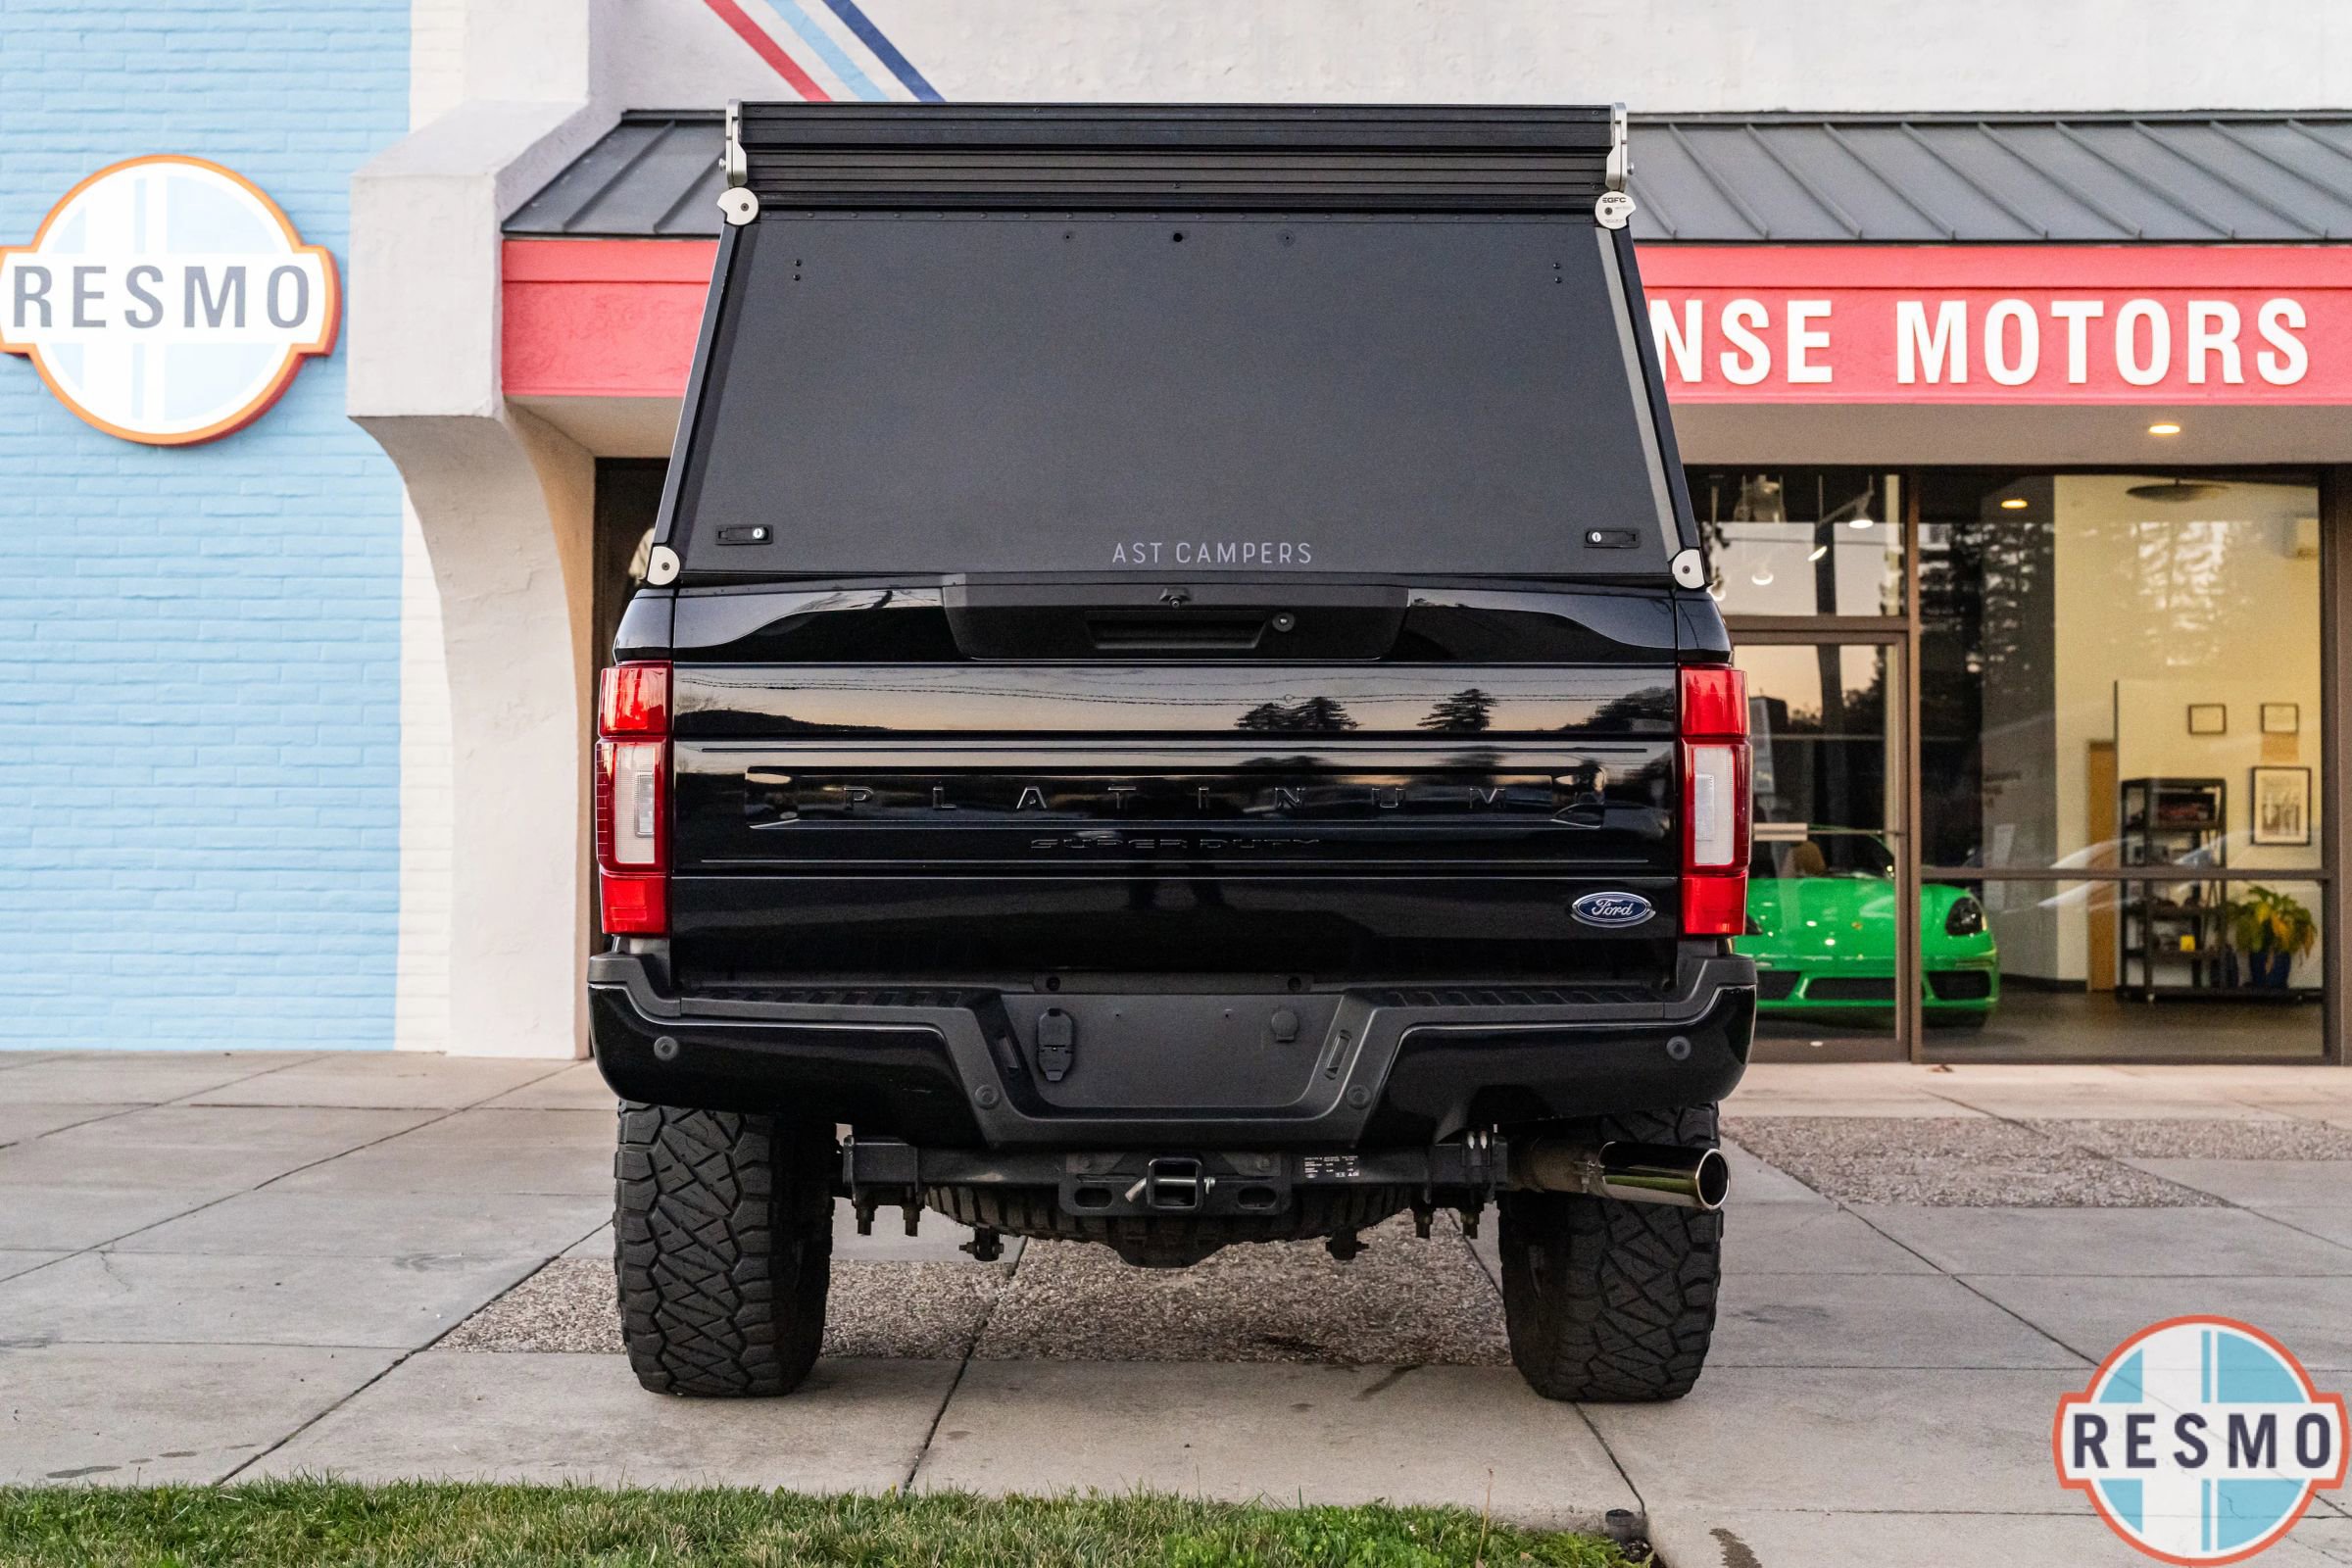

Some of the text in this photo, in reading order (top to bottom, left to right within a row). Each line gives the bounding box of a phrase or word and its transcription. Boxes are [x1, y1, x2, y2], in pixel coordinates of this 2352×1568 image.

[13, 265, 310, 329] RESMO
[1895, 297, 2310, 386] MOTORS
[1111, 542, 1313, 564] AST CAMPERS
[843, 785, 1506, 811] PLATINUM
[1030, 838, 1321, 850] SUPER DUTY
[1591, 898, 1635, 916] Ford
